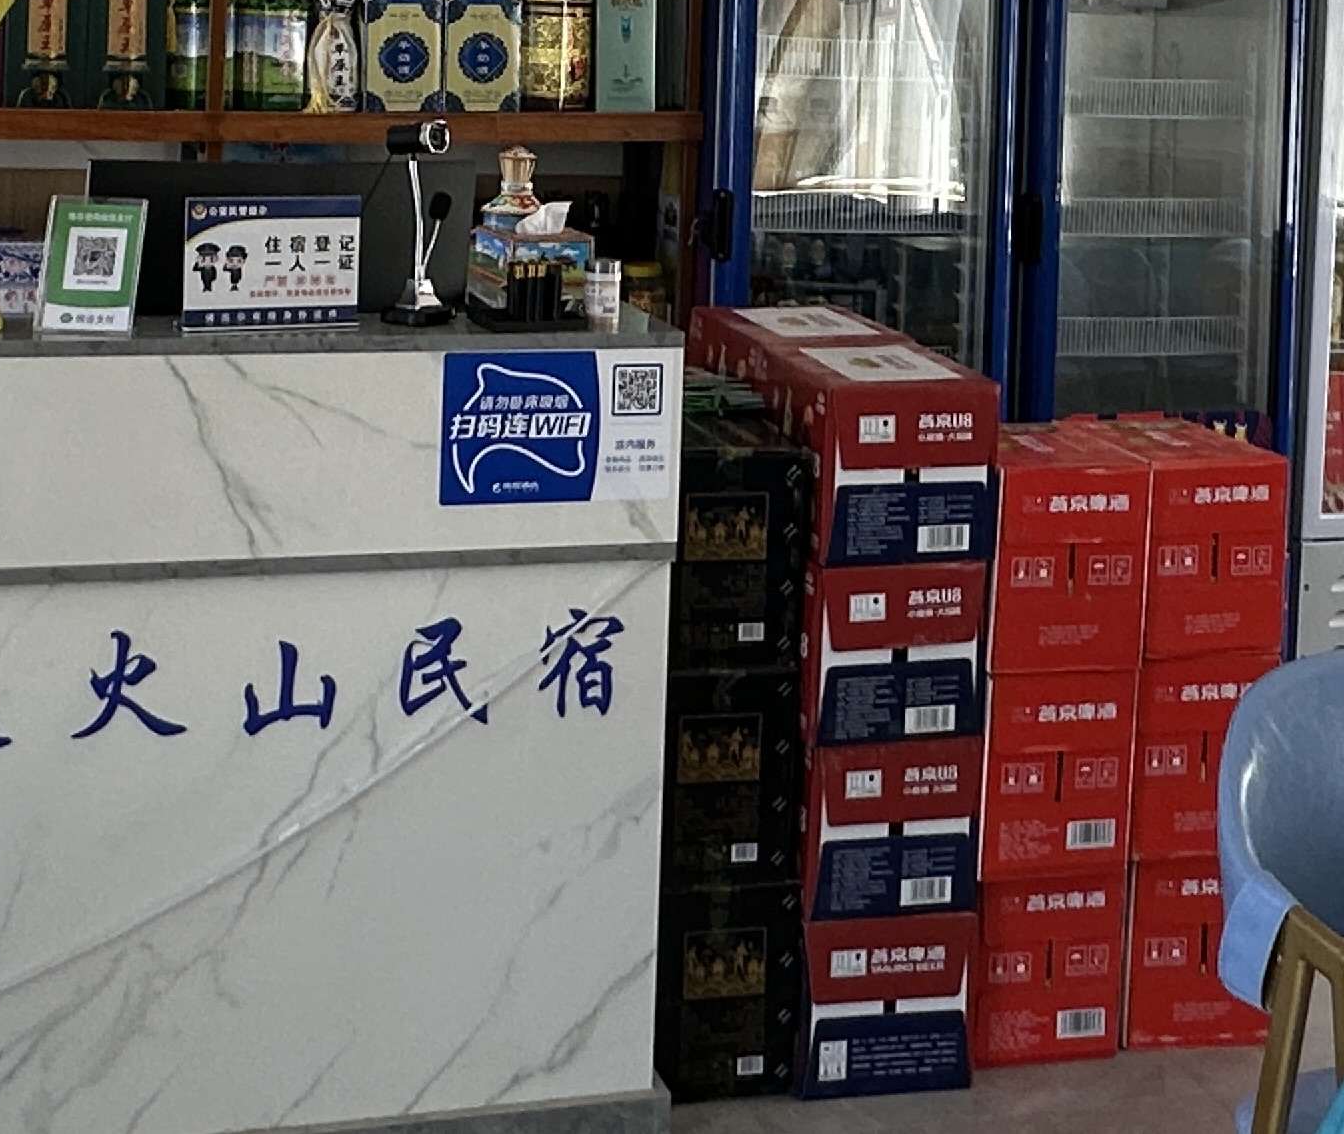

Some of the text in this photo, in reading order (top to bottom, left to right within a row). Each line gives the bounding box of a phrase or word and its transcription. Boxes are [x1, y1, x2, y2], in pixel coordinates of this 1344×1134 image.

[264, 234, 355, 255] 住宿登记
[264, 254, 355, 272] 一人一证
[480, 395, 570, 411] 请勿卧床吸烟
[1048, 493, 1130, 513] 燕京啤酒
[1195, 484, 1270, 504] 燕京啤酒
[1038, 702, 1118, 723] 燕京啤酒
[1026, 890, 1106, 912] 燕京啤酒
